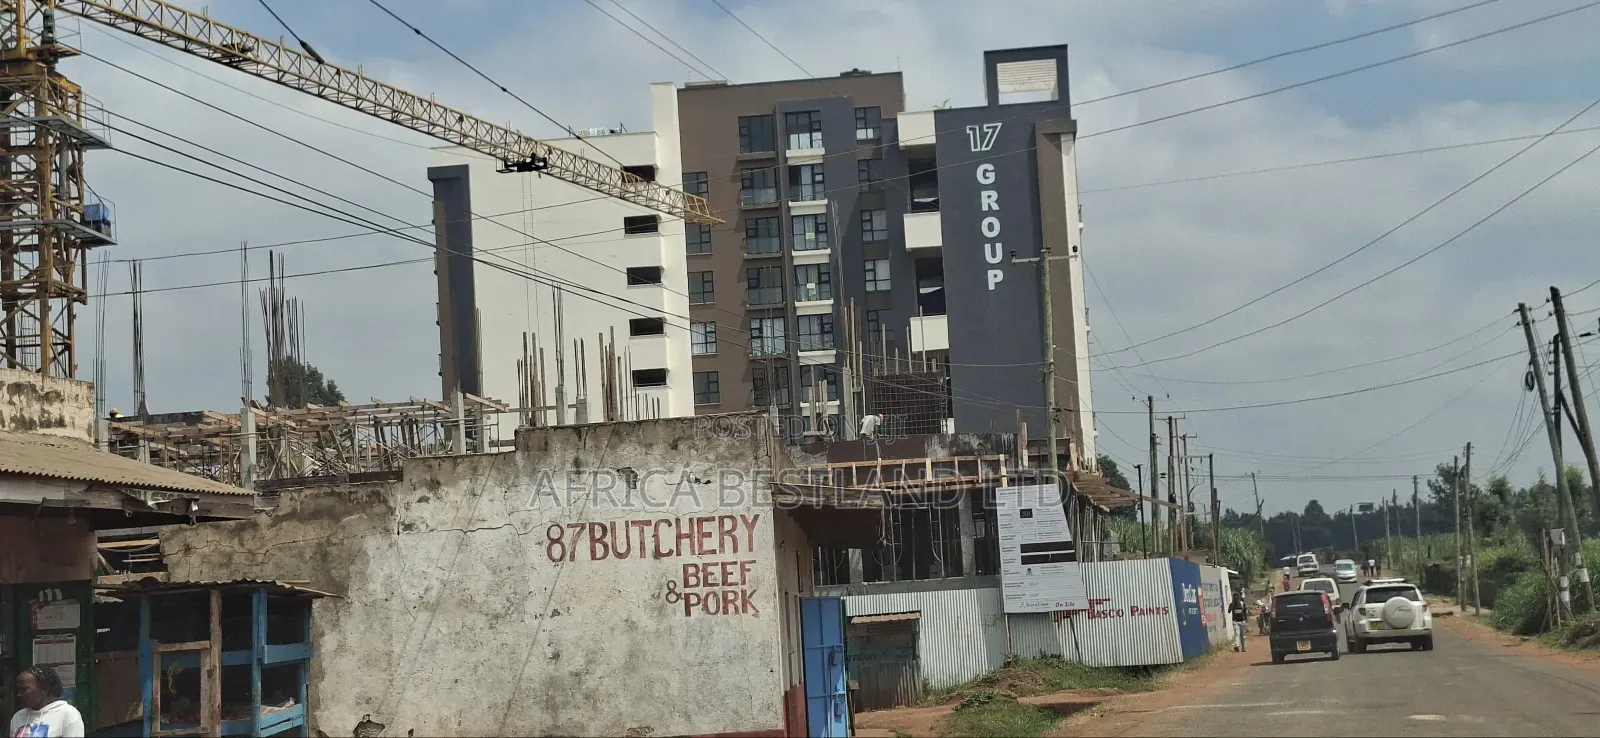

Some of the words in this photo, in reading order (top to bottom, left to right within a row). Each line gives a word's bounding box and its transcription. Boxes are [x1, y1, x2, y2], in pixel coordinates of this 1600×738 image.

[966, 122, 1003, 152] 17
[976, 163, 1004, 291] GROUP
[683, 559, 757, 589] BEEF
[683, 588, 761, 617] PORK
